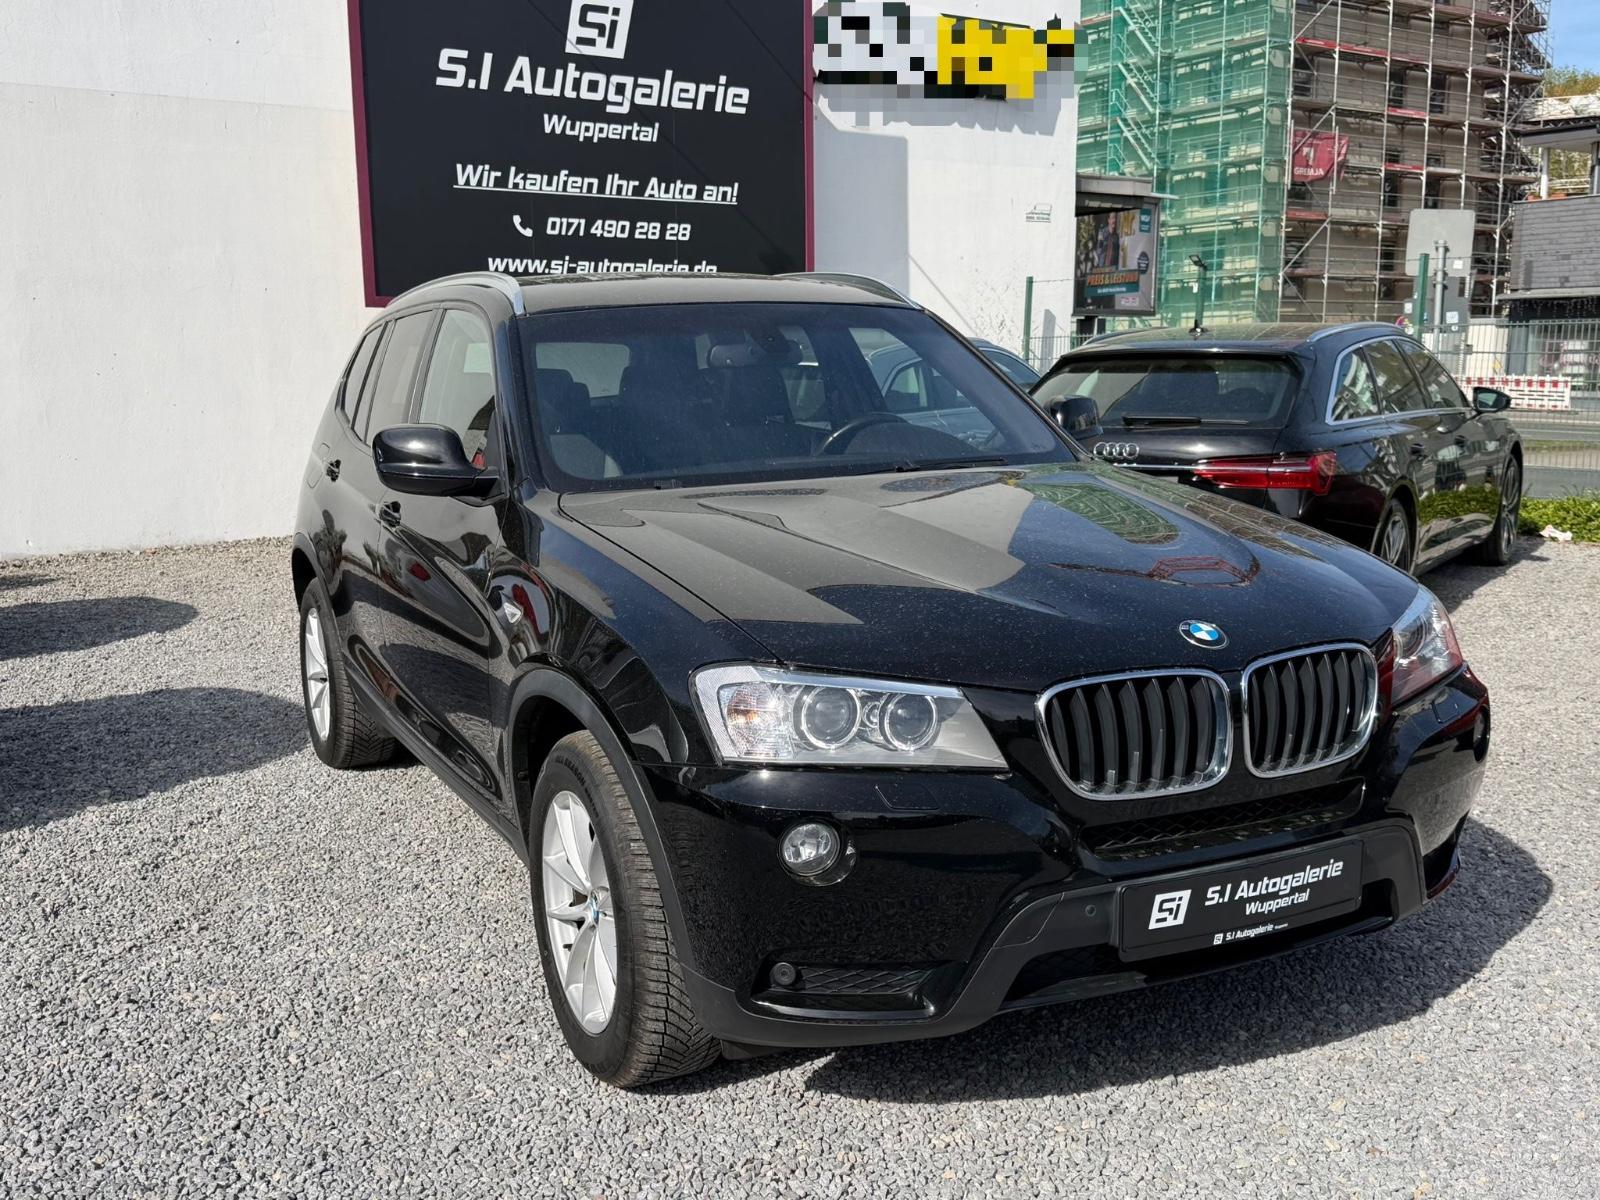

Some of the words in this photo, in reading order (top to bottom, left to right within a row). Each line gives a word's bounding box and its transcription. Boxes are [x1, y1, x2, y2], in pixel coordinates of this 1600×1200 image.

[435, 48, 494, 91] S.I
[503, 55, 750, 115] Autogalerie
[543, 113, 660, 144] Wuppertal
[455, 163, 502, 189] Wir
[507, 166, 600, 196] kaufen
[605, 173, 640, 197] Ihr
[643, 176, 697, 201] Auto
[702, 182, 739, 204] an!
[546, 217, 586, 237] 0171
[589, 219, 631, 239] 490
[634, 221, 662, 240] 28
[664, 222, 692, 241] 28
[487, 255, 717, 273] www.si-autogaleriede
[1204, 883, 1232, 906] S.I
[1234, 858, 1344, 900] Autogalerie
[1245, 888, 1310, 916] Wuppertal
[1236, 923, 1274, 938] Autogalerie
